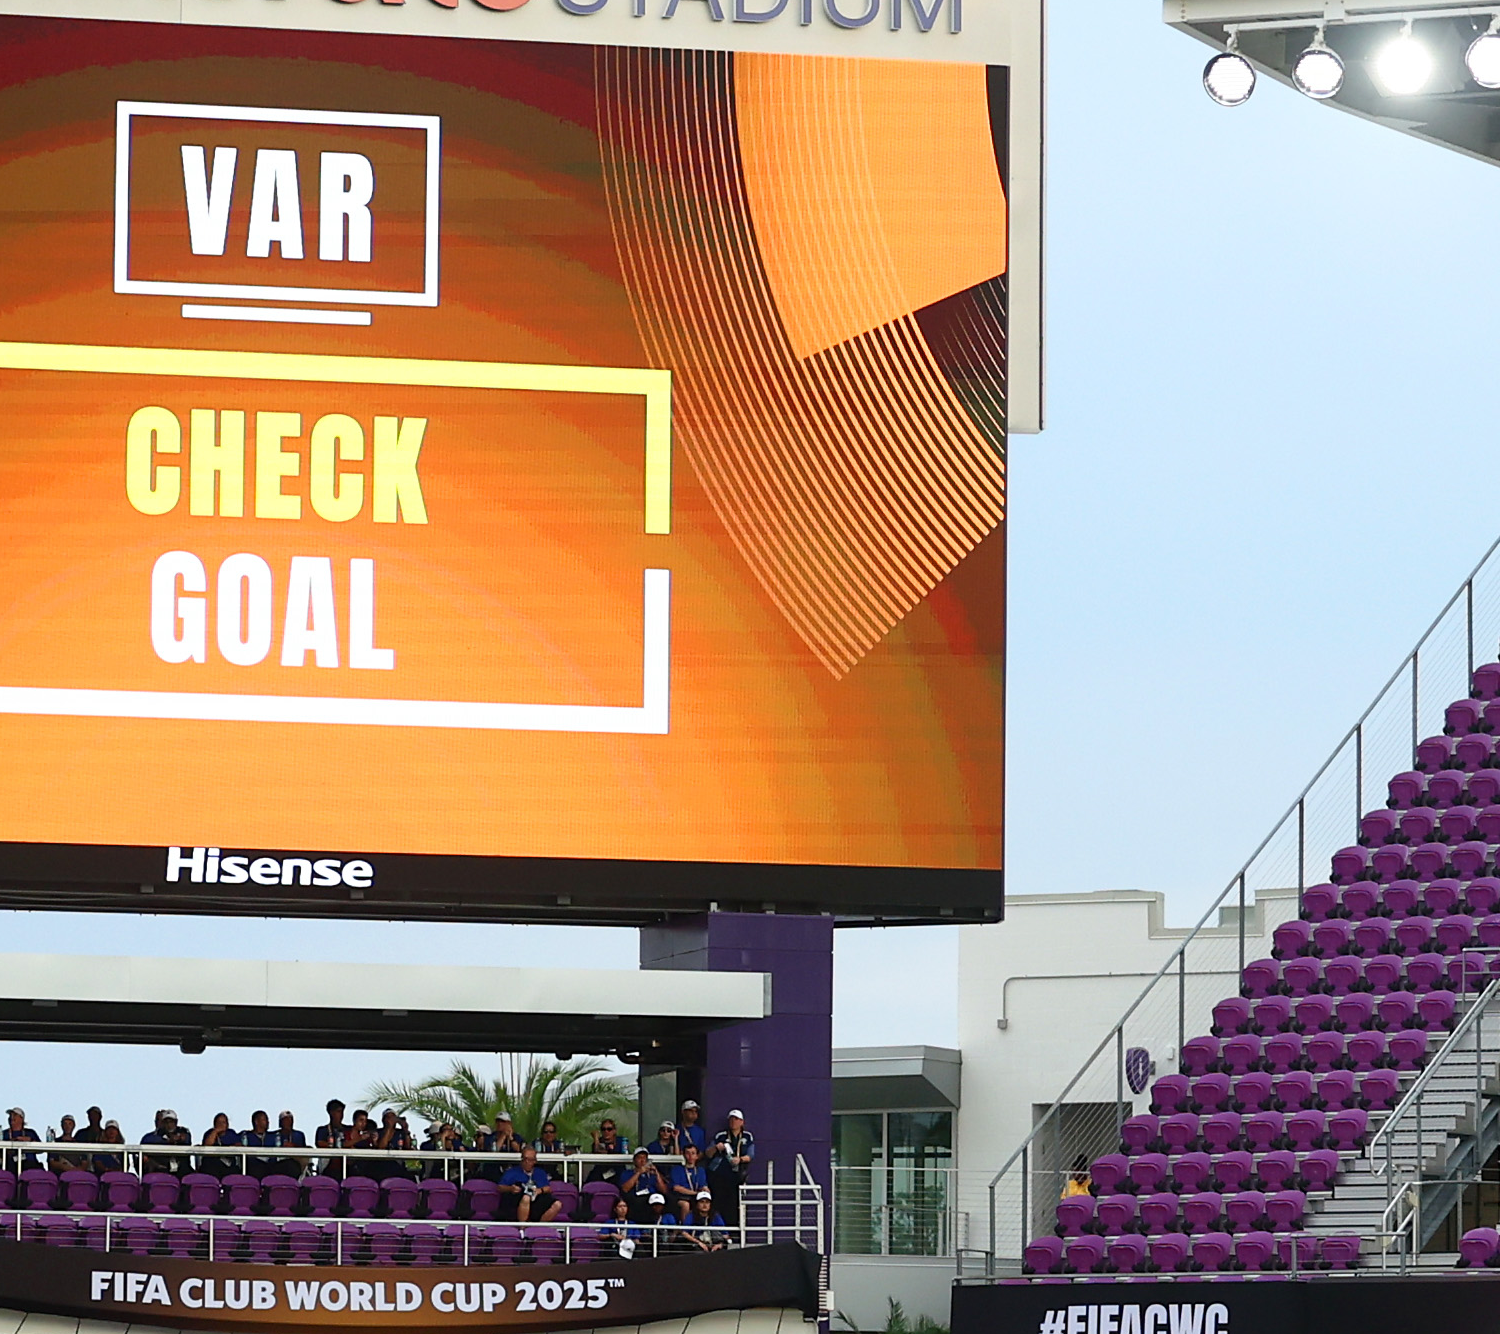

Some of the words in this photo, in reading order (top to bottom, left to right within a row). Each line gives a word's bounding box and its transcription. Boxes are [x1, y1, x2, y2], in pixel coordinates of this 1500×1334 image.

[183, 145, 374, 262] VAR
[126, 404, 429, 526] CHECK
[150, 551, 397, 671] GOAL
[166, 846, 374, 890] Hisense
[90, 1271, 172, 1307] FIFA
[180, 1278, 276, 1311] CLUB
[285, 1281, 422, 1312] WORLD
[430, 1282, 506, 1313] CUP
